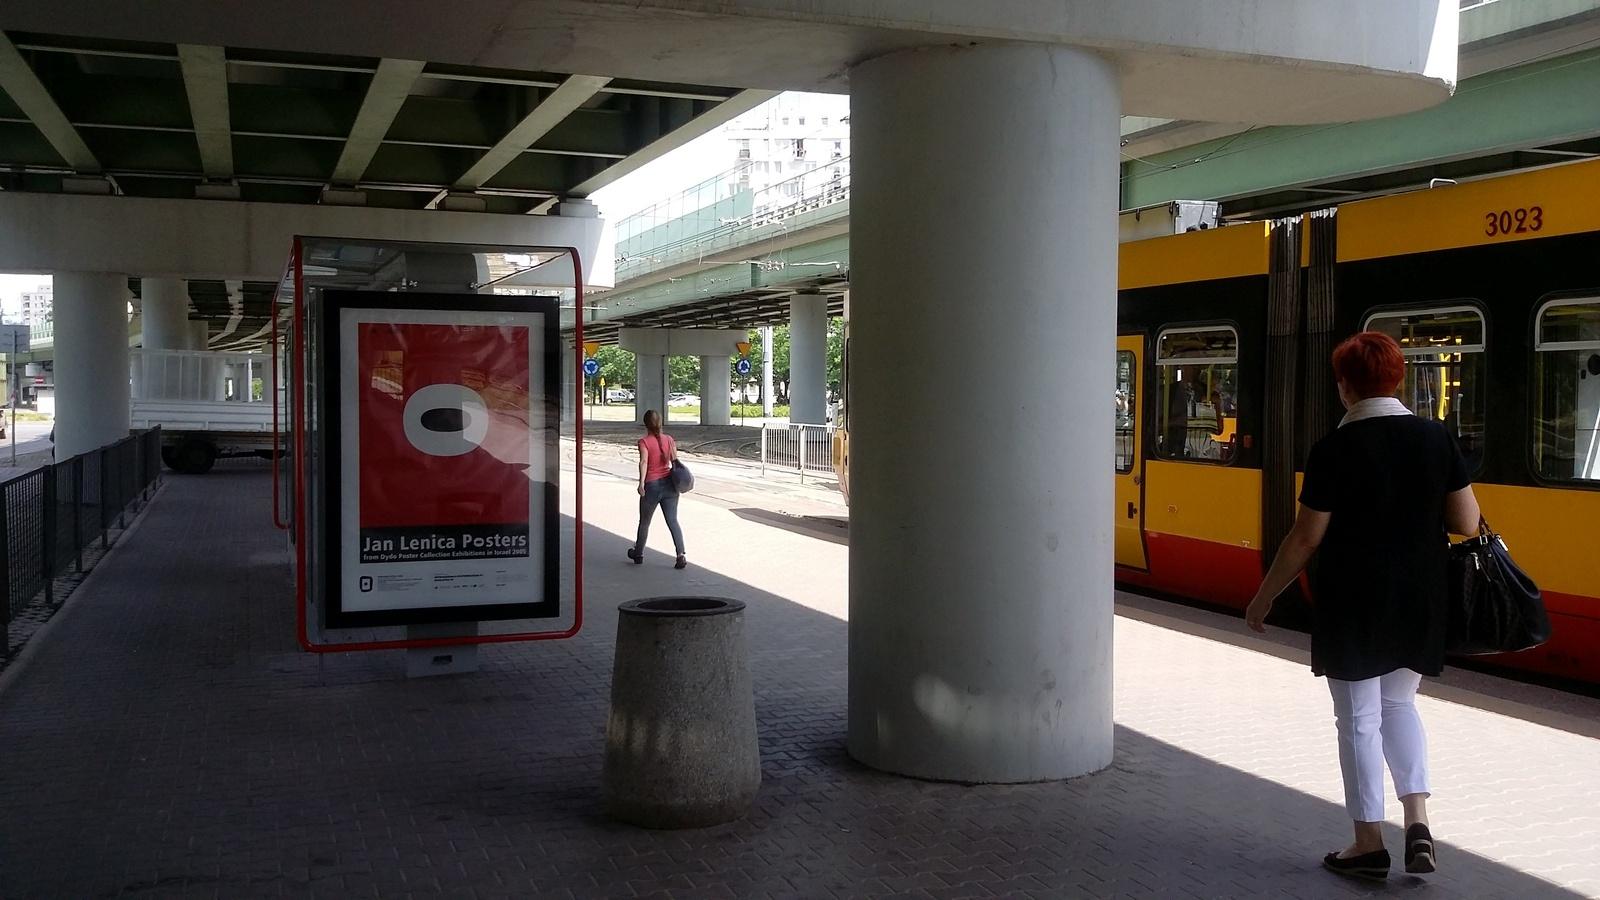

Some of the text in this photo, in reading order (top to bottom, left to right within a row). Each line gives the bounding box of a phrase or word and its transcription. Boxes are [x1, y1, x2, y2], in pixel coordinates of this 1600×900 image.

[1485, 206, 1543, 237] 3023
[363, 533, 527, 552] Jan Lenica Posters
[363, 553, 379, 561] from
[420, 551, 450, 559] Collection
[494, 548, 511, 556] Israel
